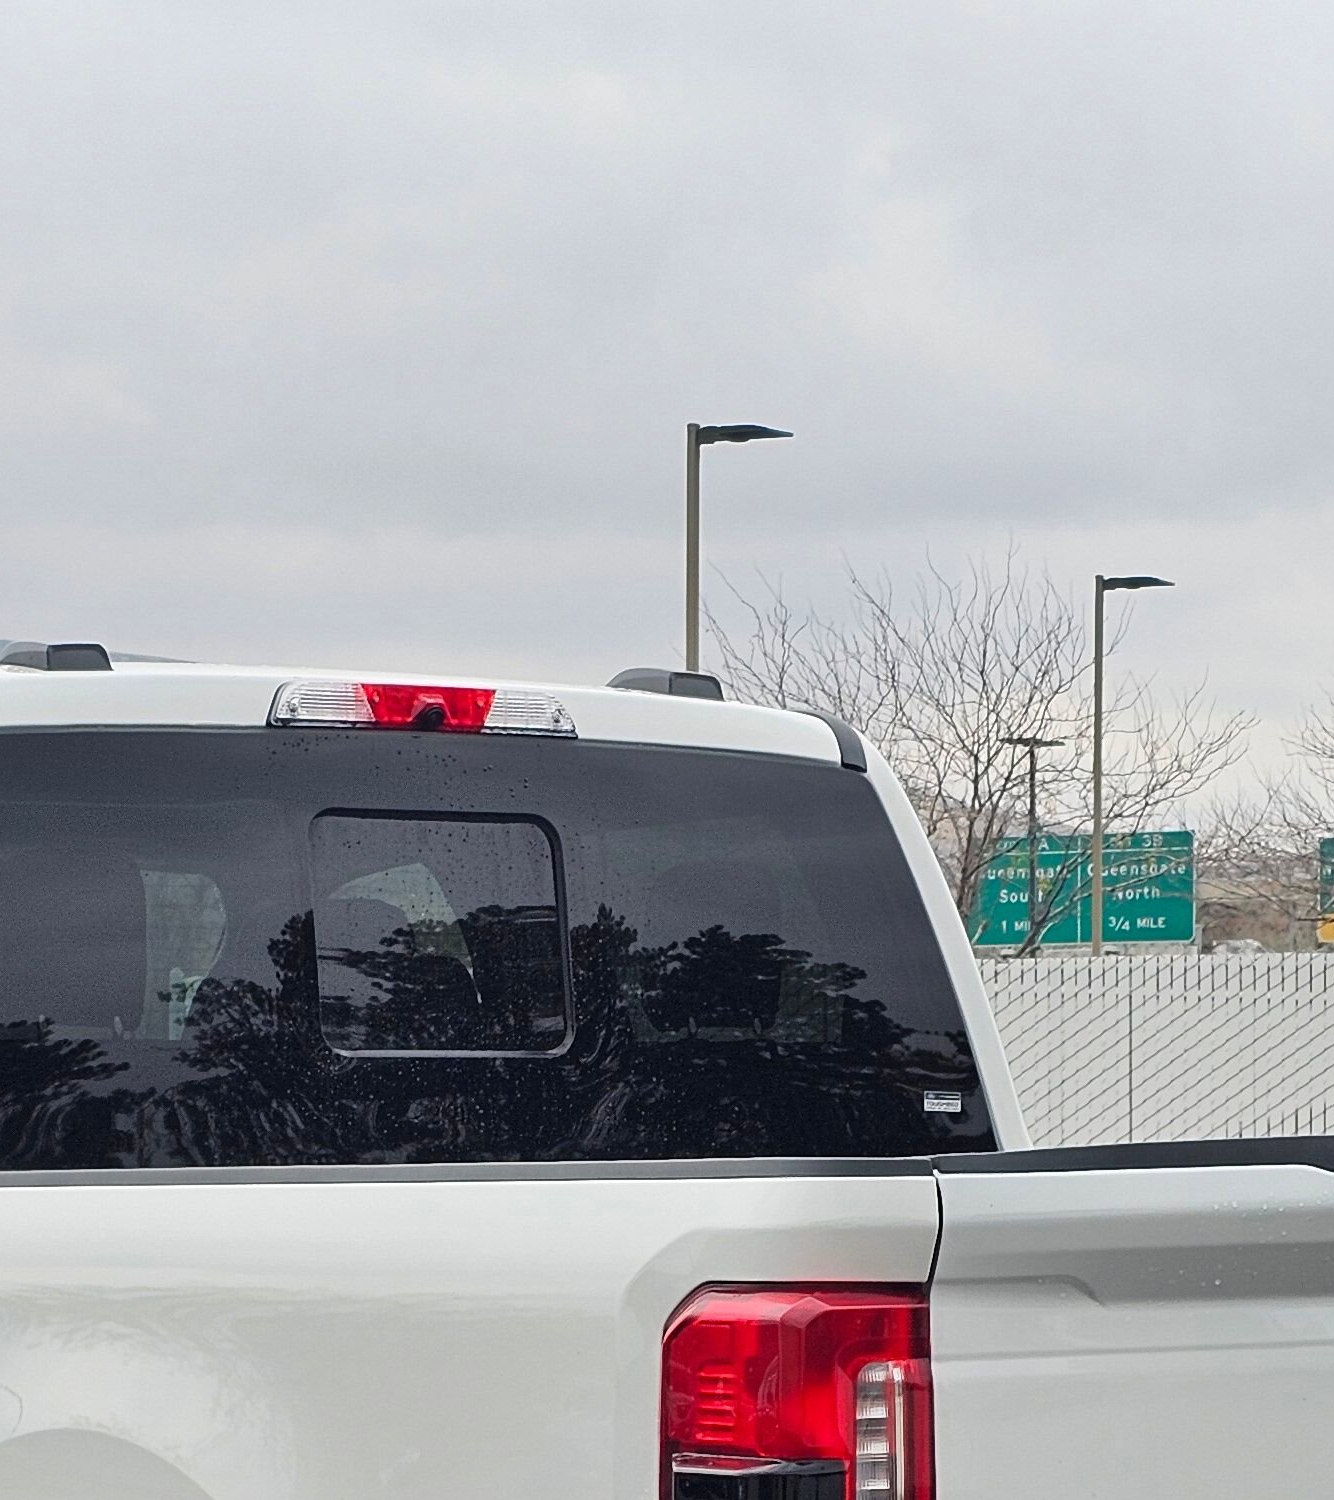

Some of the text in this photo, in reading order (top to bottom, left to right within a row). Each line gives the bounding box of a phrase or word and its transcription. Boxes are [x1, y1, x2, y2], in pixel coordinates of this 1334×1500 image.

[1141, 834, 1164, 848] 3B
[981, 865, 1071, 881] ueengat
[1108, 916, 1167, 932] 3/4 MILE
